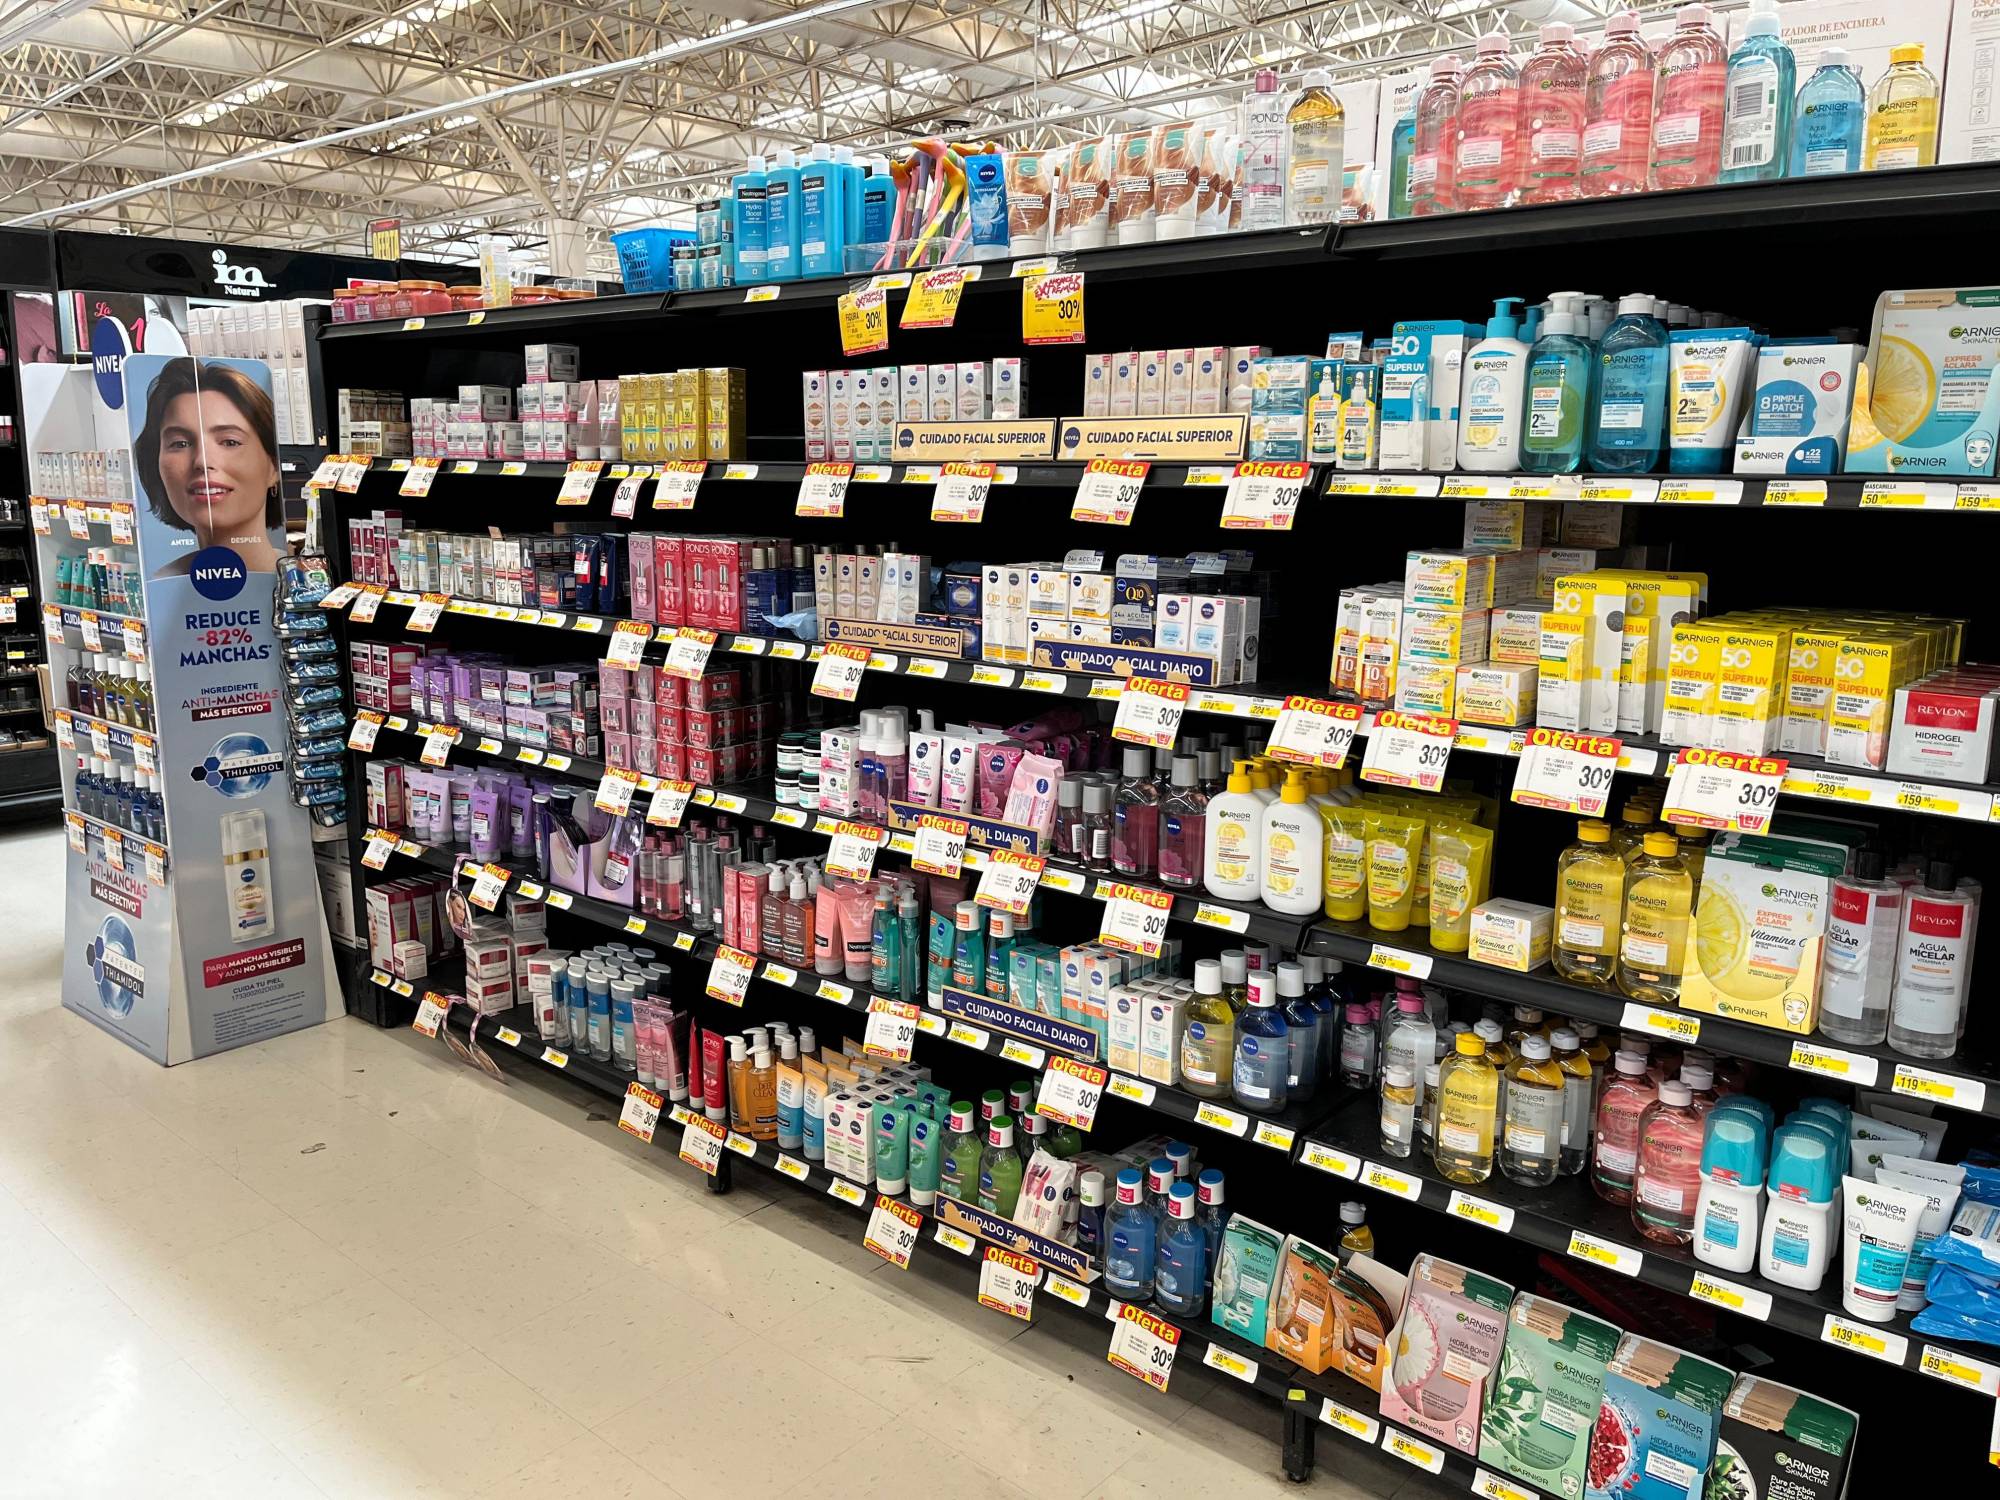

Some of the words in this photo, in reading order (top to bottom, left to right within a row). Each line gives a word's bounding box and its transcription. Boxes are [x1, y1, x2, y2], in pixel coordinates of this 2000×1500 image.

[1819, 21, 1831, 33] DE
[1833, 16, 1885, 31] ENCIMERA
[1541, 80, 1580, 90] GARNIER
[224, 285, 260, 297] Natural
[1684, 346, 1727, 356] GARNIER
[1602, 354, 1646, 365] GARNIER
[1783, 357, 1825, 366] GARNIER
[1944, 355, 1982, 363] EXPRESS
[1386, 364, 1409, 372] SUPER
[1411, 363, 1425, 371] UV
[1761, 397, 1770, 409] 8
[1773, 395, 1804, 403] PIMPLE
[1772, 403, 1804, 412] PATCH
[920, 433, 961, 444] CUIDADO
[964, 433, 995, 444] FACIAL
[998, 433, 1045, 444] SUPERIOR
[1087, 432, 1134, 443] CUIDADO
[1137, 431, 1174, 443] FACIAL
[1176, 431, 1233, 442] SUPERIOR
[1741, 451, 1784, 460] GARNIER
[1891, 456, 1946, 467] GARNIER
[809, 464, 850, 475] Oferta
[1091, 460, 1145, 476] Oferta
[1240, 463, 1303, 478] Oferta
[170, 538, 195, 546] ANTES
[230, 535, 262, 544] DESPUÉS
[656, 541, 680, 552] POND'S
[712, 545, 736, 556] POND'S
[195, 568, 242, 580] NIVEA
[1414, 583, 1445, 594] Vitamina
[1446, 584, 1453, 592] C
[1557, 580, 1597, 591] GARNIER
[1126, 586, 1144, 601] Q10
[185, 610, 261, 630] REDUCE
[1542, 621, 1568, 632] SUPER
[1570, 623, 1582, 632] UV
[196, 628, 252, 646] -82%
[1410, 635, 1440, 646] Vitamina
[1441, 638, 1448, 646] C
[1675, 633, 1720, 644] GARNIER
[1727, 636, 1774, 649] GARNIER
[826, 644, 867, 660] Oferta
[1841, 645, 1888, 658] GARNIER
[1060, 650, 1114, 667] CUIDADO
[1159, 662, 1204, 677] DIARIO
[1366, 666, 1379, 681] 10
[1722, 673, 1753, 684] SUPER
[1755, 675, 1768, 685] UV
[201, 683, 259, 695] INGREDIENTE
[1129, 678, 1184, 698] Oferta
[1837, 684, 1867, 695] SUPER
[1869, 687, 1883, 697] UV
[182, 689, 279, 710] ANTI-MANCHAS
[1461, 697, 1491, 707] Vitamina
[1493, 699, 1501, 707] C
[200, 707, 220, 718] MÁS
[1289, 697, 1357, 720] Oferta
[1918, 705, 1967, 718] REVLON
[1380, 711, 1451, 735] Oferta
[1532, 729, 1613, 756] Oferta
[1915, 731, 1963, 743] HIDROGEL
[1686, 749, 1778, 774] Oferta
[225, 762, 281, 777] THIAMIDOL
[839, 822, 878, 841] Oferta
[921, 815, 965, 834] Oferta
[993, 850, 1041, 871] Oferta
[1369, 862, 1399, 874] Vitamina
[1400, 866, 1407, 874] C
[85, 861, 148, 899] ANTI-MANCHAS
[95, 883, 108, 898] MÁS
[1115, 884, 1168, 908] Oferta
[1761, 884, 1819, 902] GARNIER
[1755, 916, 1787, 927] ACLARA
[1757, 909, 1793, 921] EXPRESS
[1916, 914, 1956, 926] REVLON
[1750, 929, 1796, 947] Vitamina
[1798, 938, 1808, 948] C
[1909, 949, 1955, 961] MICELAR
[1918, 942, 1947, 953] AGUA
[205, 963, 227, 974] PARA
[228, 952, 268, 969] MANCHAS
[269, 943, 302, 958] VISIBLES
[225, 965, 242, 979] AÚN
[244, 963, 255, 974] NO
[105, 968, 142, 995] THIAMIDOL
[233, 985, 254, 994] CUIDA
[267, 977, 281, 987] PIEL
[1718, 1002, 1768, 1020] GARNIER
[966, 1002, 1012, 1024] CUIDADO
[1014, 1016, 1049, 1036] FACIAL
[1050, 1027, 1088, 1048] DIARIO
[1053, 1058, 1102, 1083] Oferta
[631, 1085, 661, 1108] Oferta
[691, 1114, 724, 1138] Oferta
[879, 1196, 919, 1227] Oferta
[1857, 1195, 1907, 1216] GARNIER
[1866, 1208, 1905, 1223] PureActive
[959, 1210, 1004, 1236] CUIDADO
[1042, 1245, 1079, 1268] DIARIO
[987, 1248, 1034, 1274] Oferta
[1123, 1305, 1175, 1343] Oferta
[1456, 1312, 1499, 1336] GARNIER
[1469, 1344, 1490, 1357] BOMB
[1927, 1346, 1953, 1358] TOALLITAS
[1553, 1361, 1601, 1386] GARNIER
[1568, 1393, 1591, 1409] BOMB
[1408, 1417, 1445, 1437] GARNIER
[1656, 1409, 1703, 1434] GARNIER
[1650, 1435, 1675, 1451] HIDRA
[1674, 1442, 1697, 1459] BOMB
[1775, 1452, 1830, 1479] GARNIER
[1511, 1465, 1549, 1486] GARNIER
[1771, 1475, 1790, 1489] Pure
[1790, 1479, 1816, 1497] Carbón
